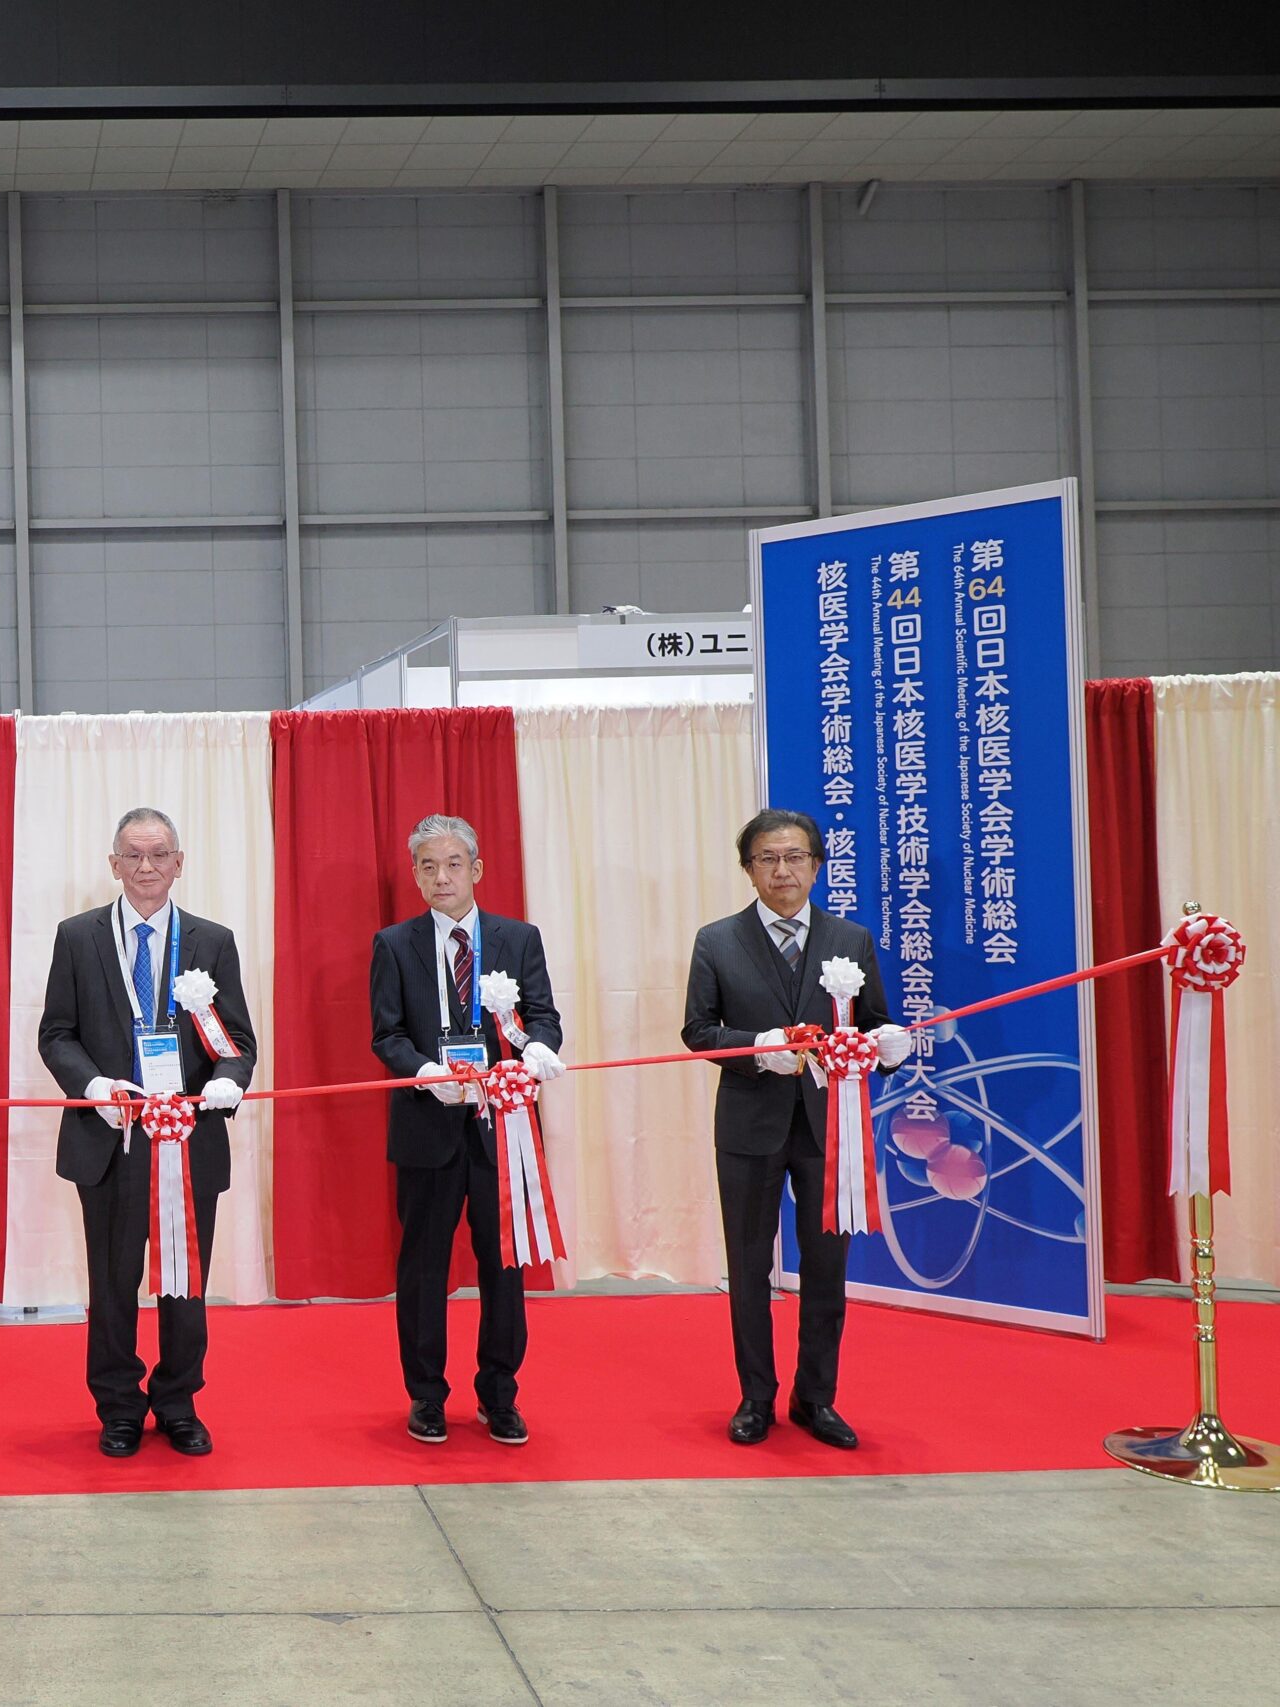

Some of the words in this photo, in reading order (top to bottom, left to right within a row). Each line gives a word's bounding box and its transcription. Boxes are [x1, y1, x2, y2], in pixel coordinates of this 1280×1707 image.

[872, 555, 881, 573] The
[954, 543, 964, 562] The
[872, 577, 881, 599] 44th
[954, 566, 964, 589] 64th
[873, 602, 882, 634] Annual
[955, 592, 965, 625] Annual
[872, 637, 883, 676] Meeting
[956, 629, 967, 674] Scientific
[875, 680, 884, 689] of
[876, 693, 885, 707] the
[955, 678, 968, 718] Meeting
[874, 711, 885, 753] Japanese
[959, 721, 969, 731] of
[960, 736, 969, 751] the
[968, 538, 1017, 965] 第64回日本核医学会学術総会
[876, 757, 887, 792] Society
[958, 755, 970, 800] Japanese
[879, 795, 888, 805] of
[880, 809, 889, 844] Nuclear
[960, 803, 972, 839] Society
[963, 843, 974, 853] of
[881, 848, 890, 891] Medicine
[964, 857, 974, 895] Nuclear
[880, 895, 892, 950] Technology
[965, 899, 976, 944] Medicine
